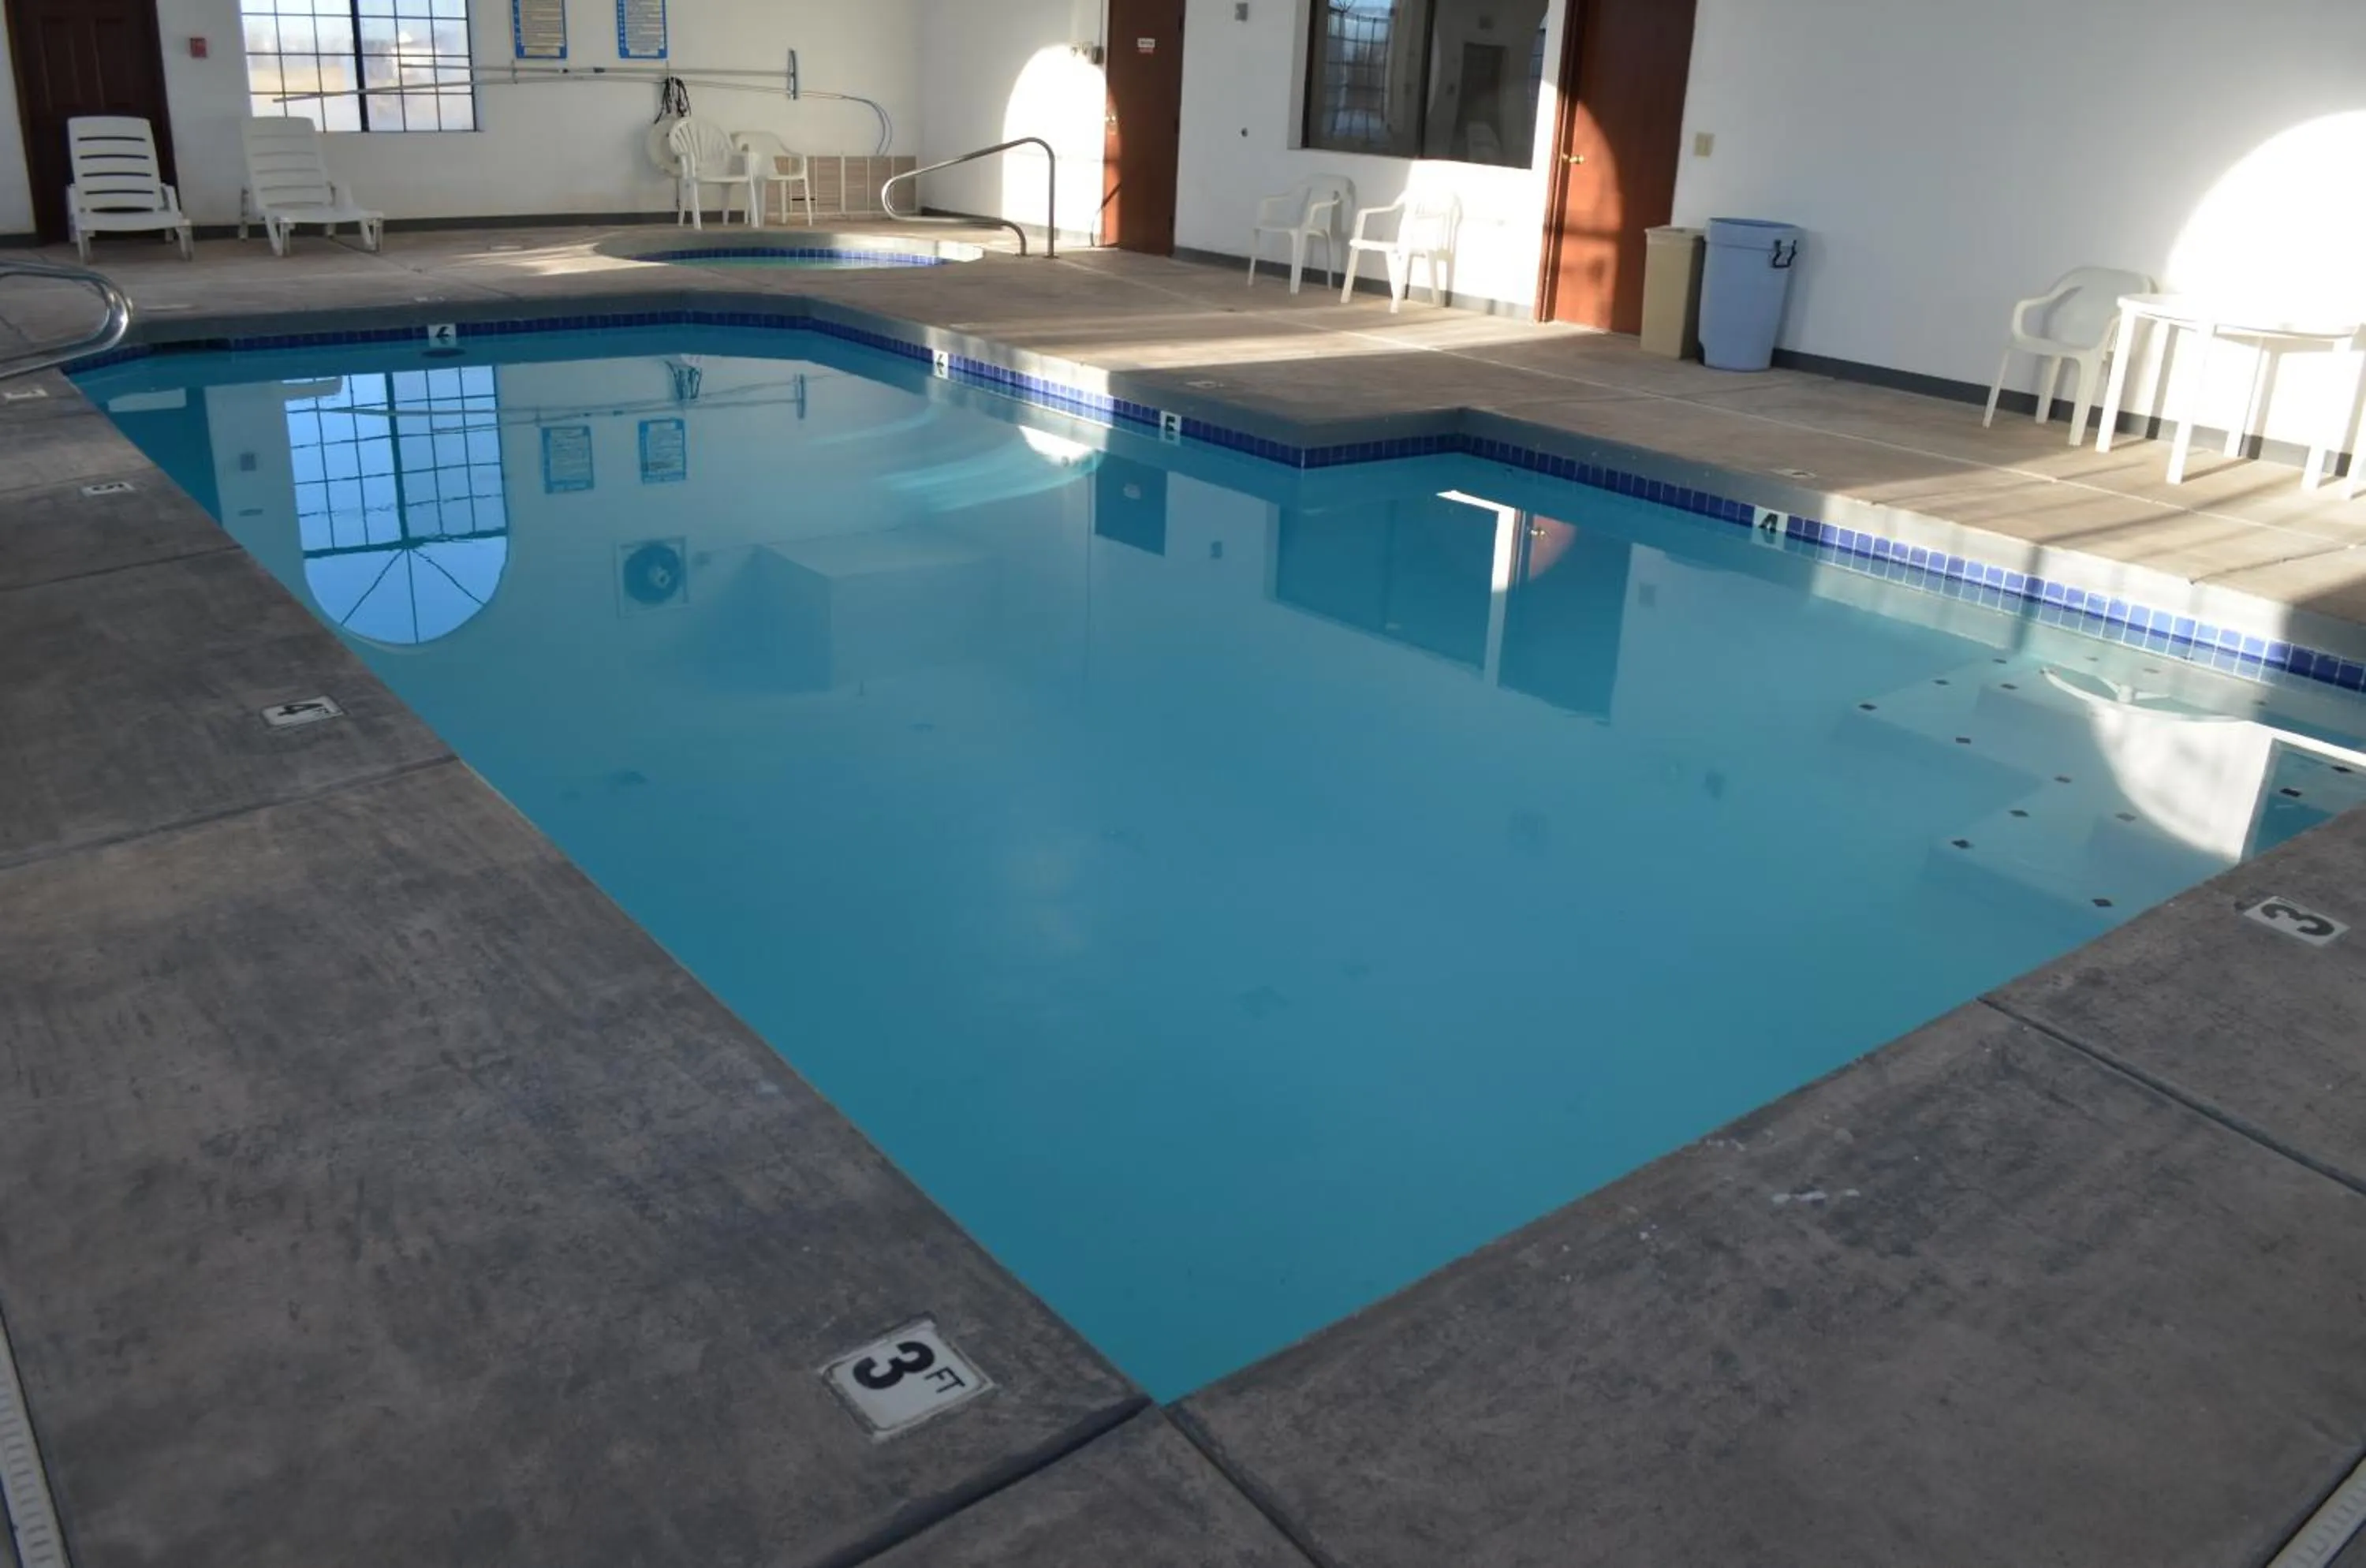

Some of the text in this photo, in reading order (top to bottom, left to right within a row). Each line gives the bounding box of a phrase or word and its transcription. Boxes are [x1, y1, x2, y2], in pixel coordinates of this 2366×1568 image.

[278, 703, 324, 716] 4
[2261, 903, 2335, 936] 3
[853, 1341, 966, 1394] 3 FT
